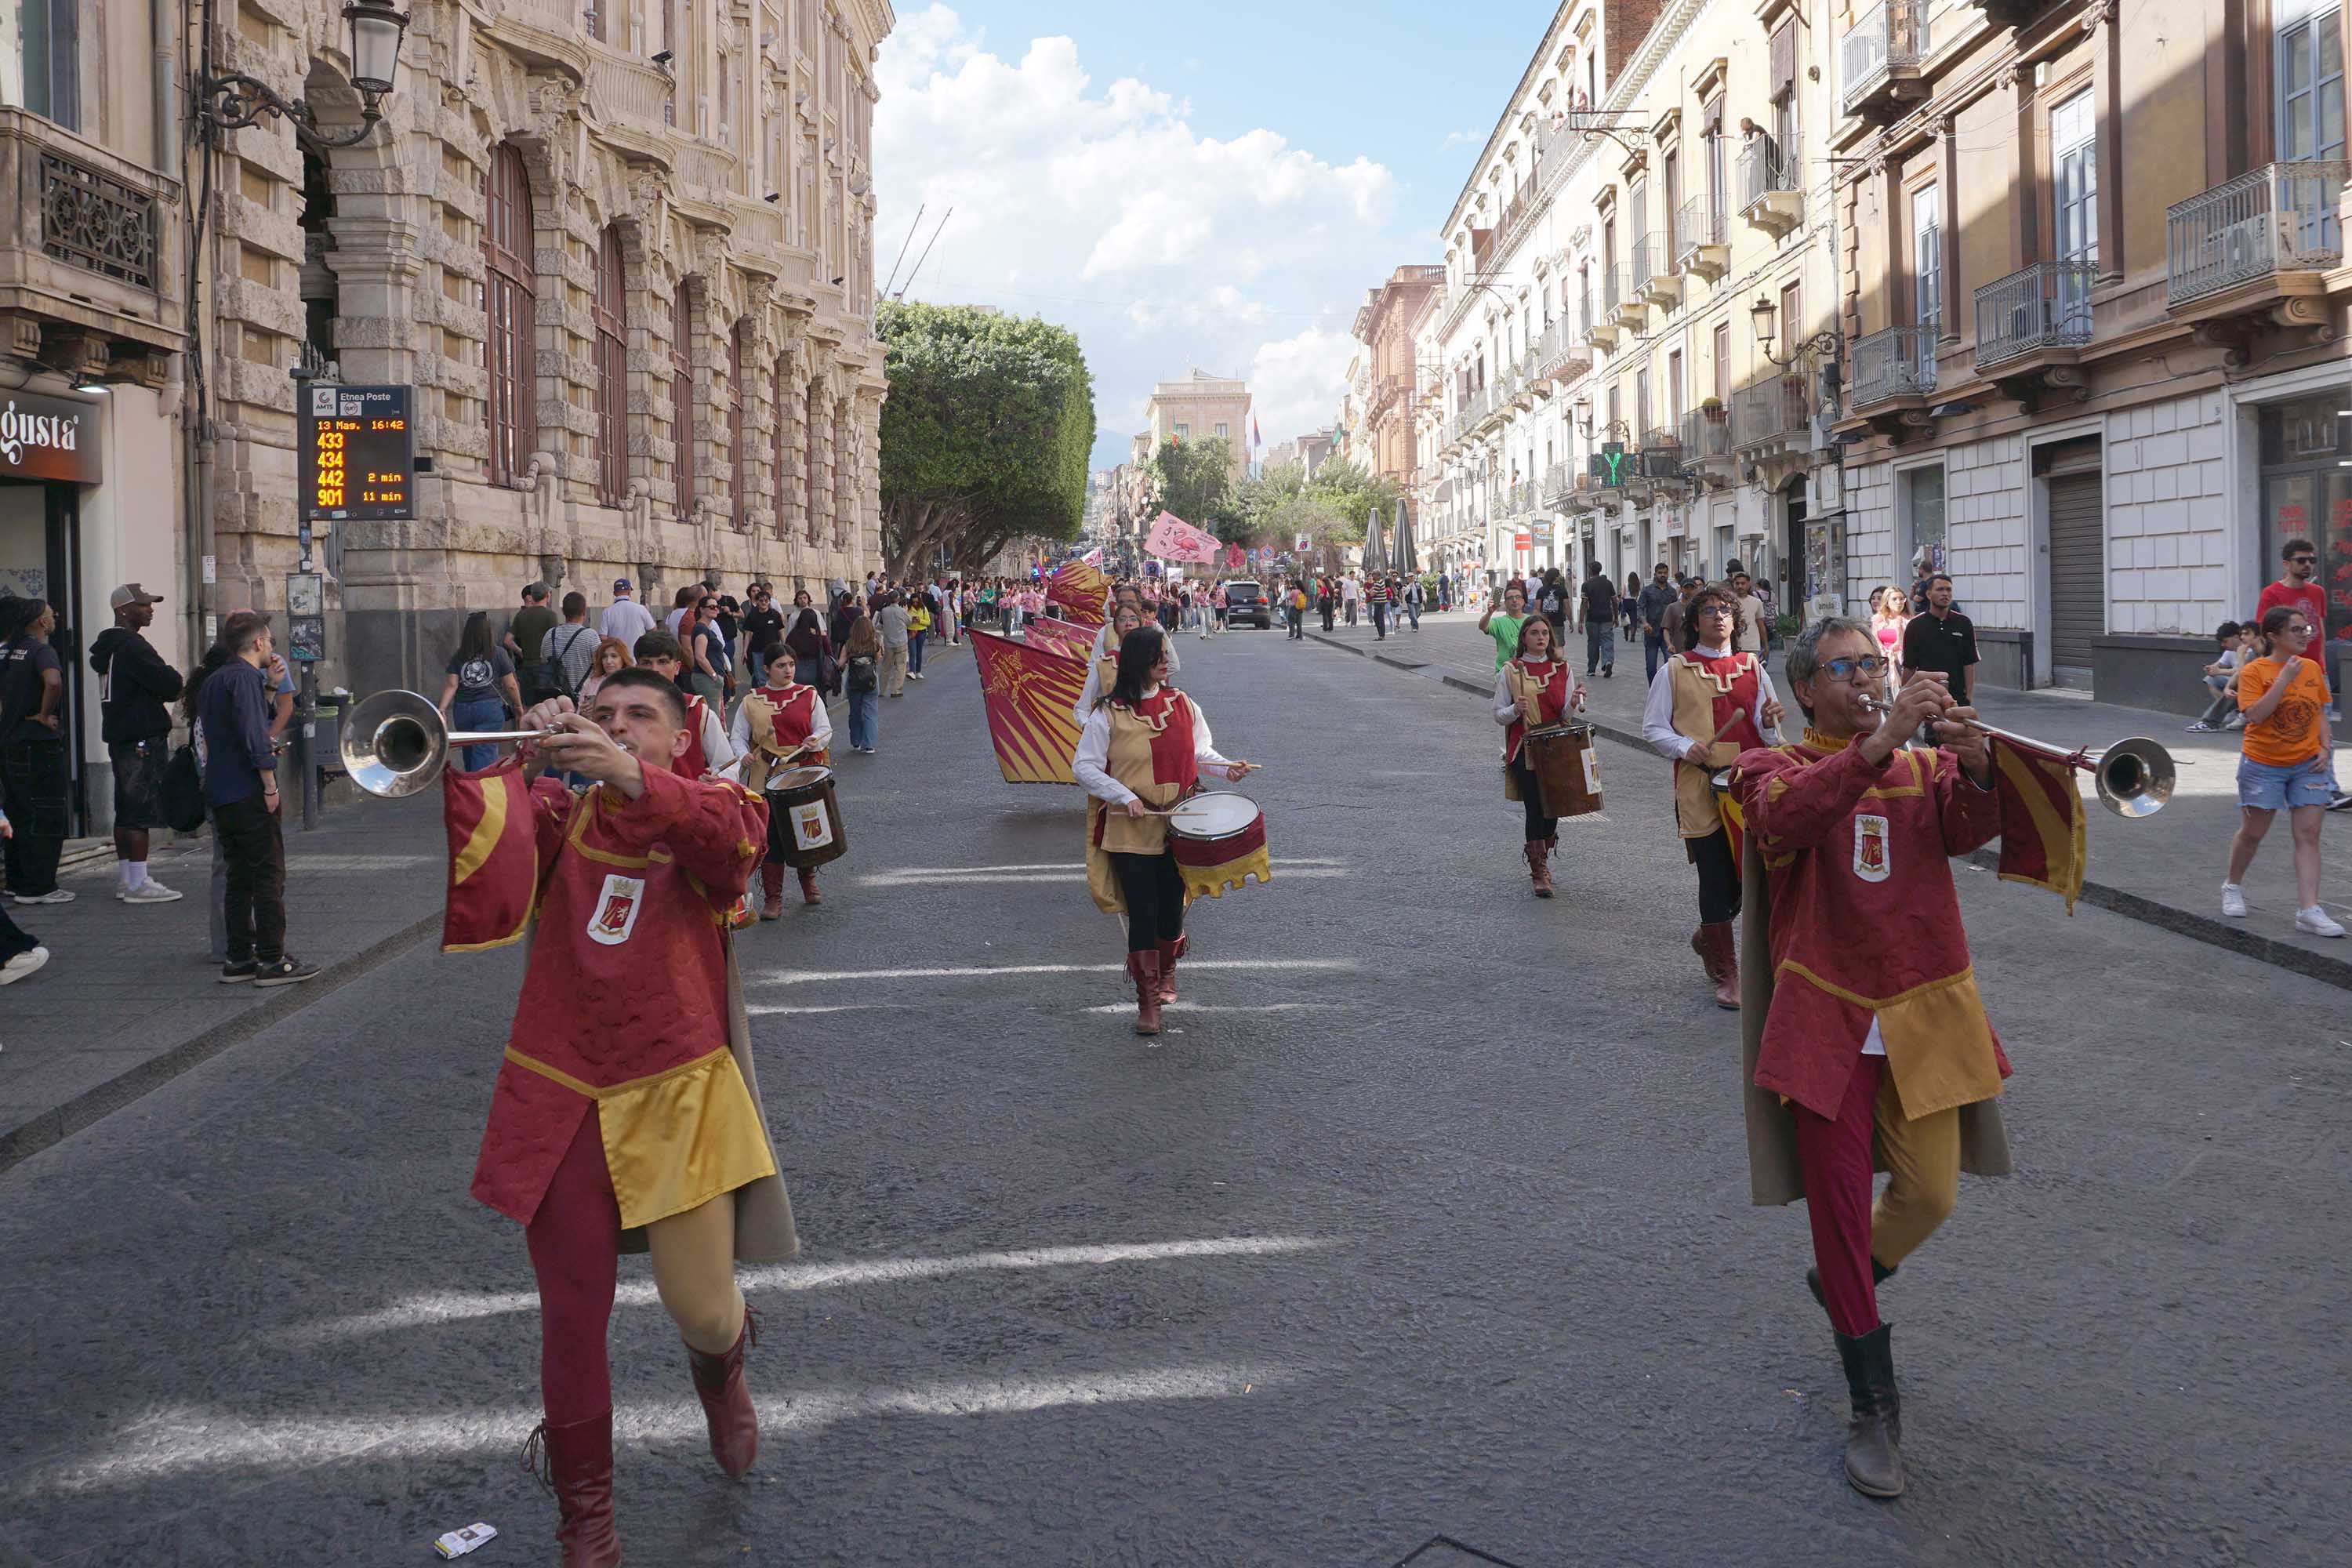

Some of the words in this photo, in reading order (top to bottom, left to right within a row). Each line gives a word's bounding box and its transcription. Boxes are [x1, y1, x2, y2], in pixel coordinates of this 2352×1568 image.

[340, 393, 365, 401] Etnea
[366, 393, 391, 401] Poste
[318, 421, 332, 430] 13
[372, 421, 405, 430] 16:42
[317, 433, 344, 449] 433
[317, 452, 344, 468] 434
[318, 470, 344, 487] 442
[368, 473, 376, 482] 2
[380, 473, 402, 482] min
[318, 489, 343, 506] 901
[363, 492, 376, 501] 11
[380, 492, 402, 501] min
